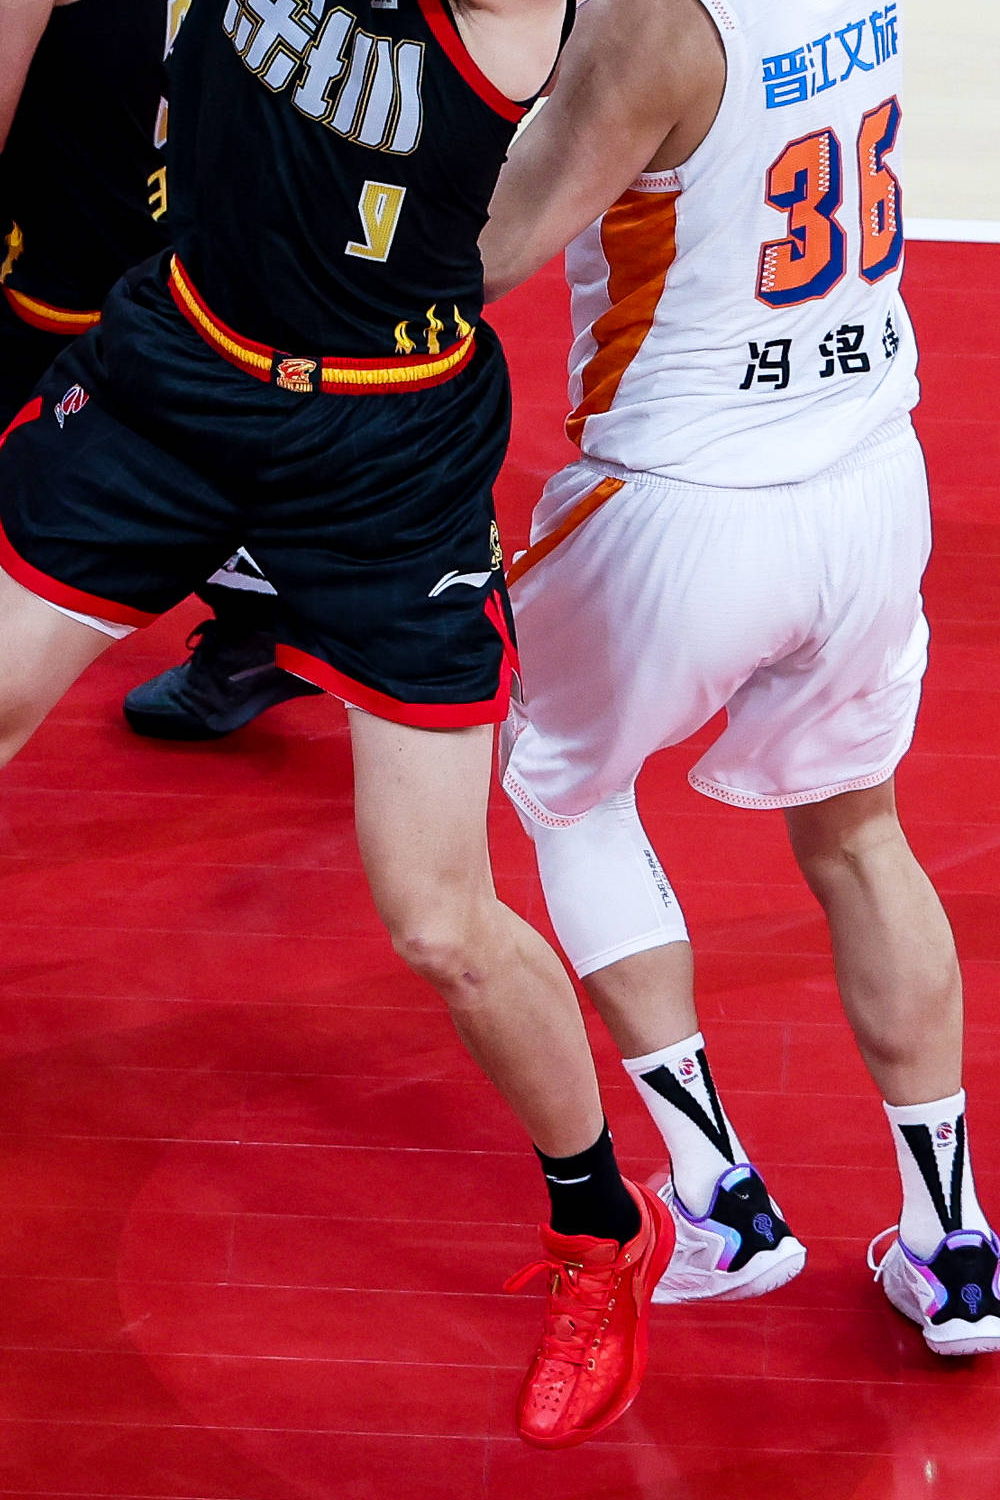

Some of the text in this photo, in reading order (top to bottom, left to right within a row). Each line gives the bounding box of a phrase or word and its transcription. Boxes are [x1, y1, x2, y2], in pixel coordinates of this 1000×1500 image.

[762, 2, 899, 109] 晋江文旅
[344, 179, 408, 263] 9
[755, 94, 904, 310] 36
